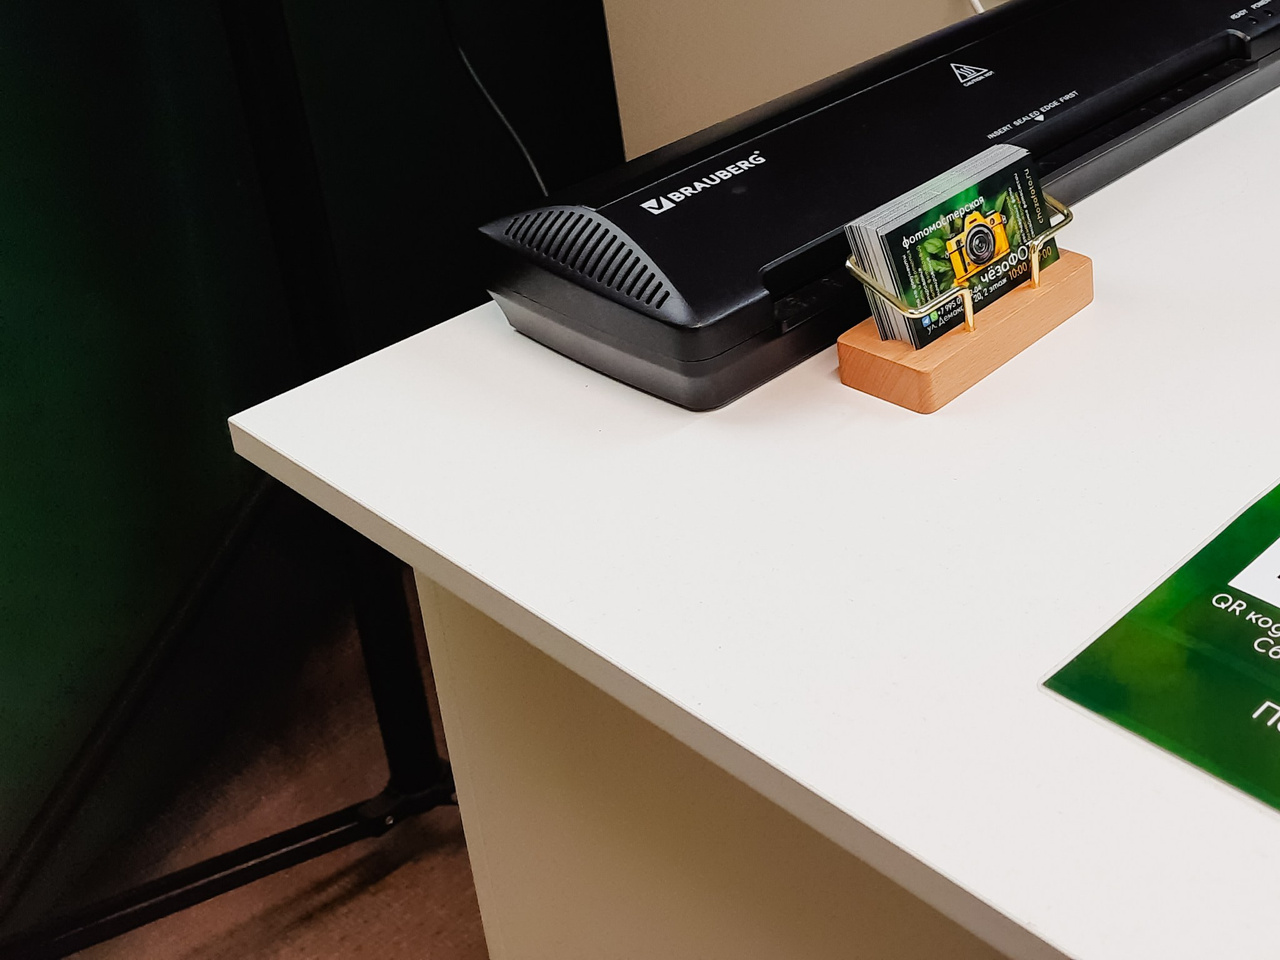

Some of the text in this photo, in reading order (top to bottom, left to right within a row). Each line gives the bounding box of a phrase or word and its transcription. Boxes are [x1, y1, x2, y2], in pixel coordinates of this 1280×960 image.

[986, 89, 1079, 140] INSERT SEALED EDGE FIRST
[666, 151, 767, 203] BRAUBERG
[1023, 167, 1045, 225] chozafoto.ru
[901, 195, 986, 250] фотомастерская
[988, 278, 1008, 292] этаж
[1007, 262, 1029, 281] 10:00
[1211, 592, 1248, 616] QR
